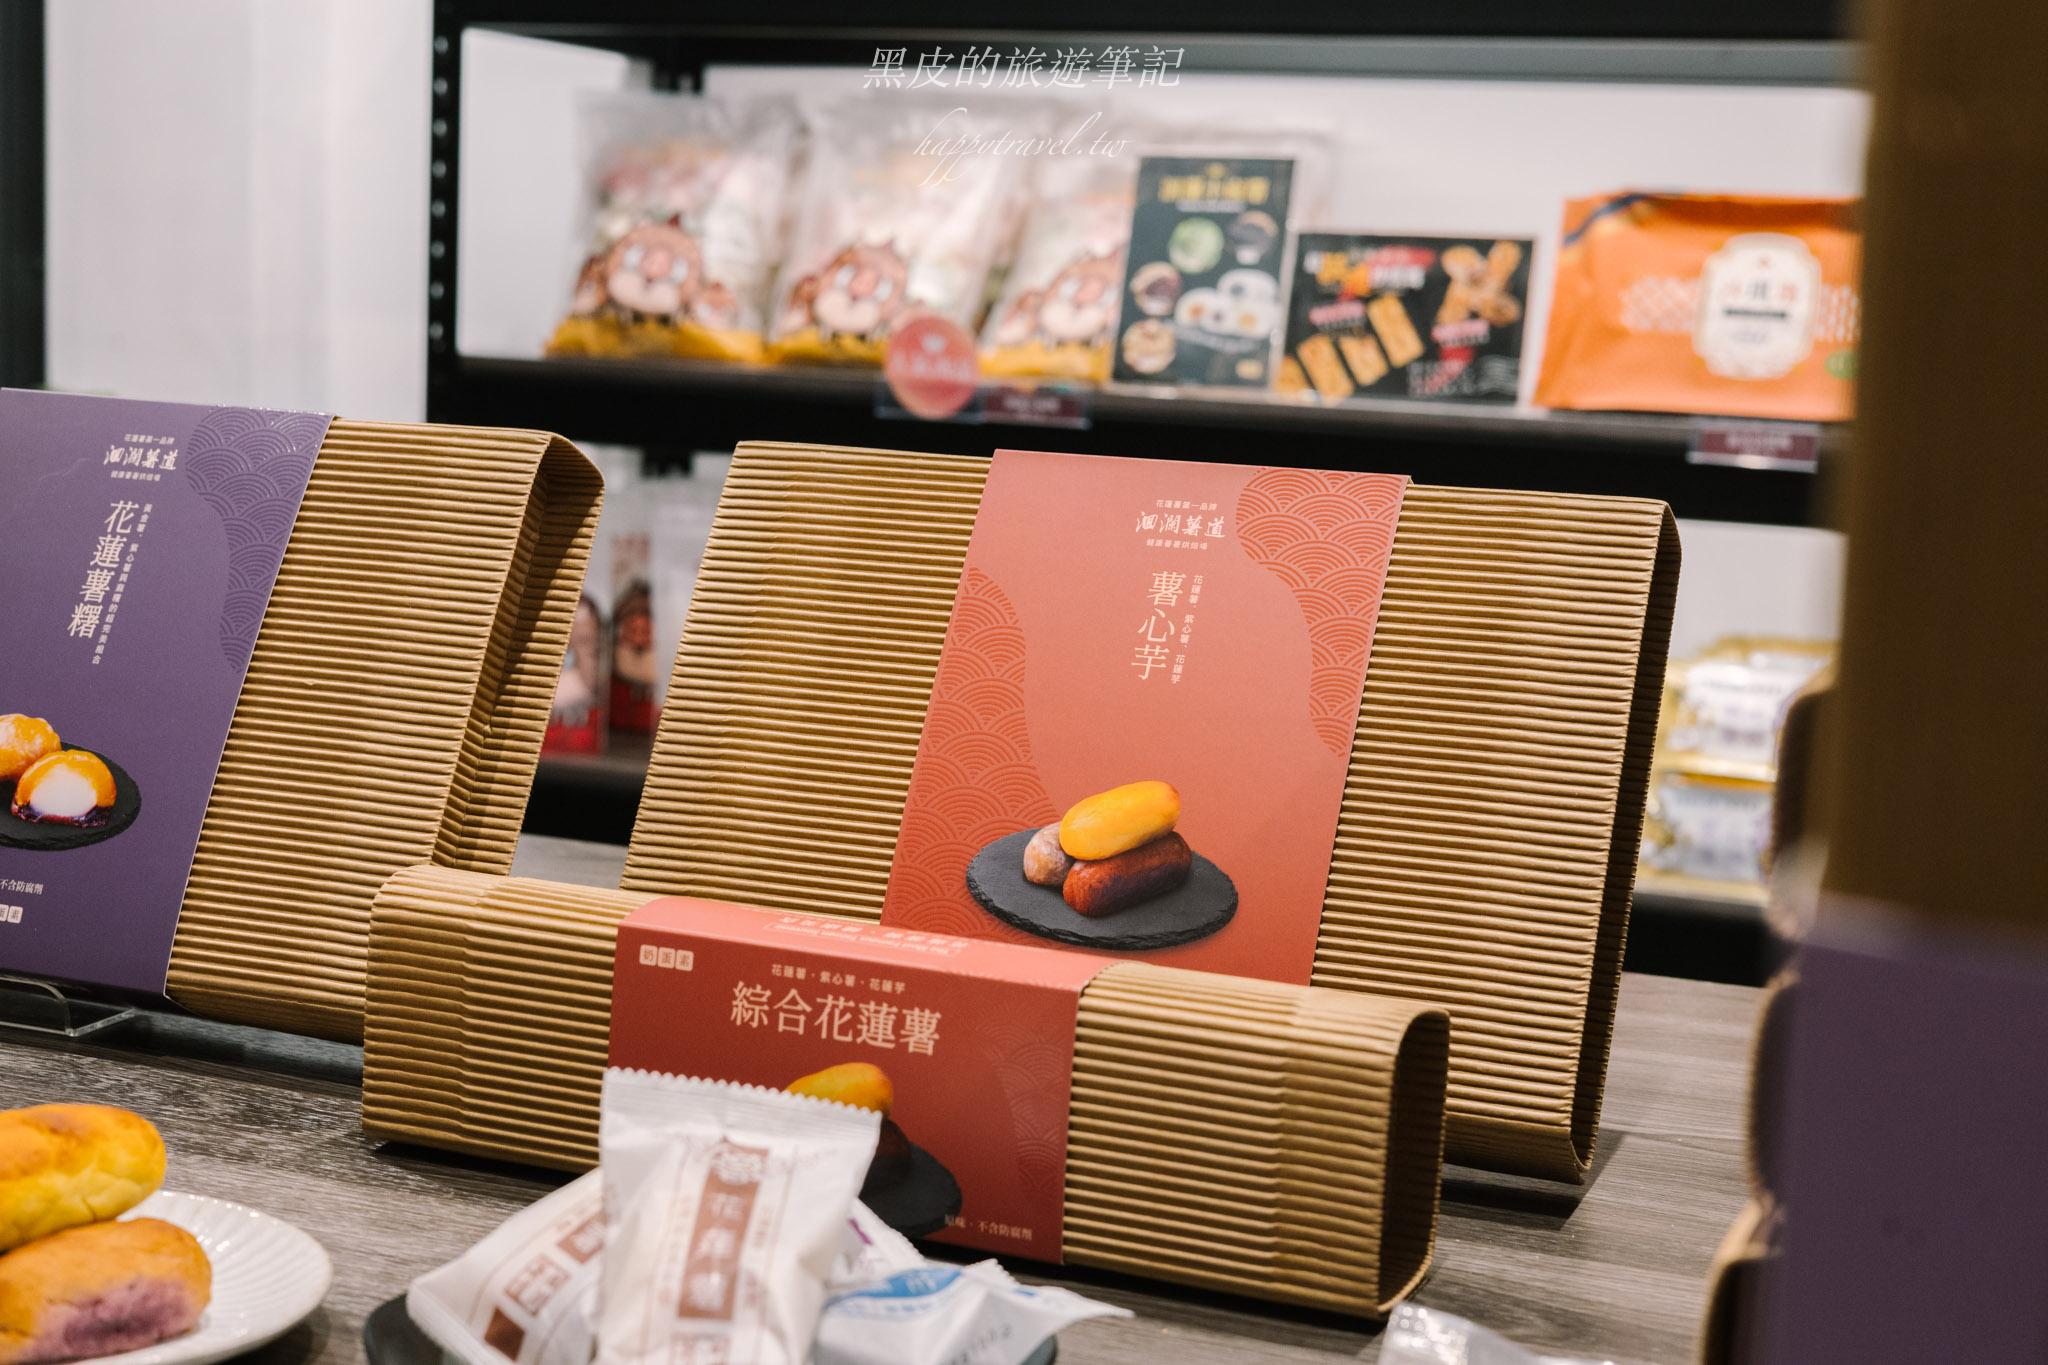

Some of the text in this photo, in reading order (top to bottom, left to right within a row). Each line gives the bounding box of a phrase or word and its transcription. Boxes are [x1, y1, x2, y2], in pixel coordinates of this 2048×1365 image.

[66, 500, 140, 639] 花蓮薯糬
[1131, 569, 1187, 680] 薯心芋
[730, 980, 942, 1056] 綜合花蓮薯
